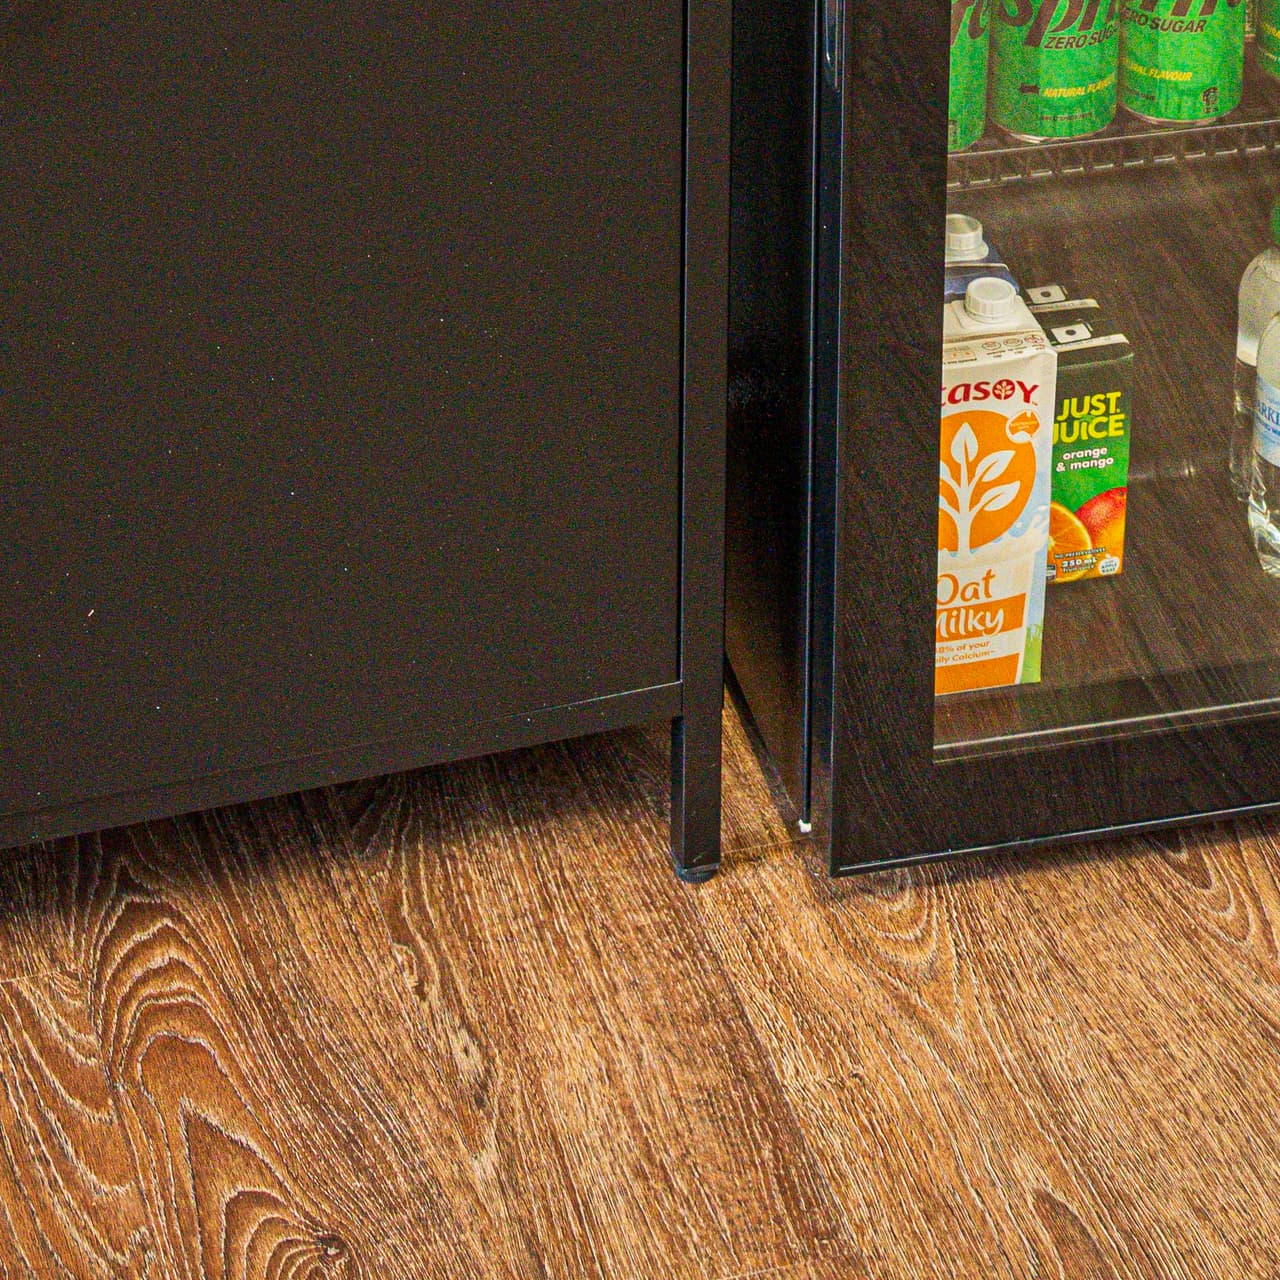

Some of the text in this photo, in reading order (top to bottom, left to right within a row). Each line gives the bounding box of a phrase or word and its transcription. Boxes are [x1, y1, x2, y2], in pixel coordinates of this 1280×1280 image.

[1148, 16, 1207, 34] SUGAR
[1043, 34, 1086, 50] ZERO
[1148, 67, 1193, 82] FLAVOUR
[1043, 86, 1086, 99] NATURAL
[1056, 391, 1122, 421] JUST
[1053, 413, 1126, 445] JUICE
[1063, 447, 1108, 461] orange
[1055, 457, 1115, 473] & mango
[937, 568, 997, 607] Oat
[968, 640, 992, 651] your
